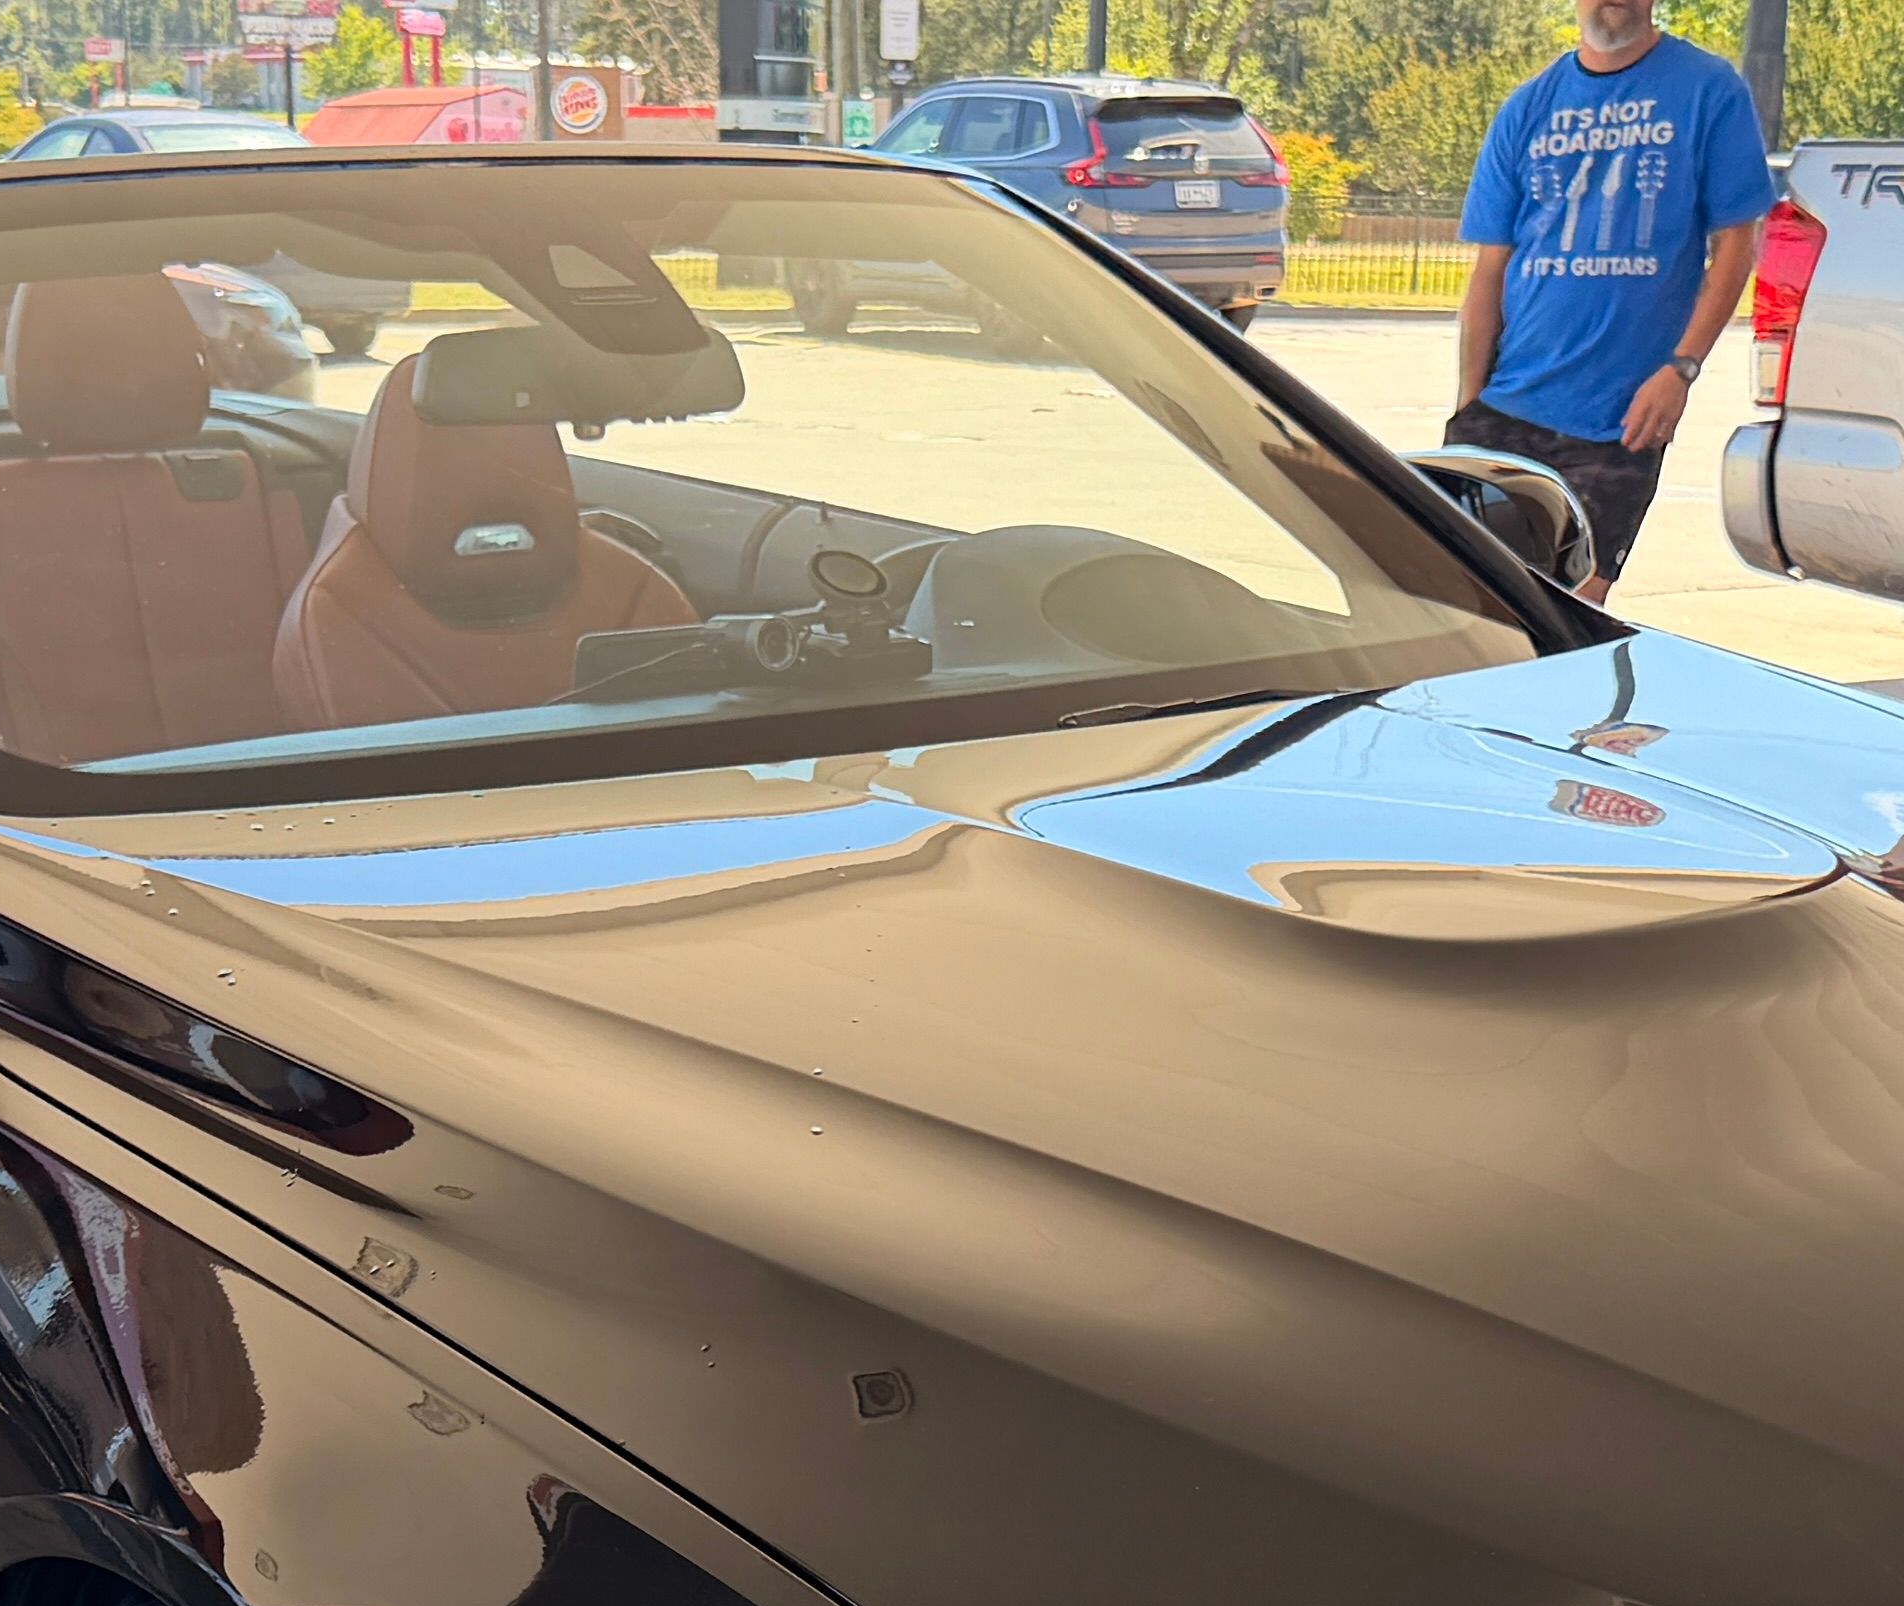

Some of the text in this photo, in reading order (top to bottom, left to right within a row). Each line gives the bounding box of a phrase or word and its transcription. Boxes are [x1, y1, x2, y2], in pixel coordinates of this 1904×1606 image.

[1551, 100, 1657, 131] IT'S NOT
[1528, 121, 1674, 160] HOARDING
[1534, 257, 1567, 277] IT'S
[1570, 257, 1658, 277] GUITARS
